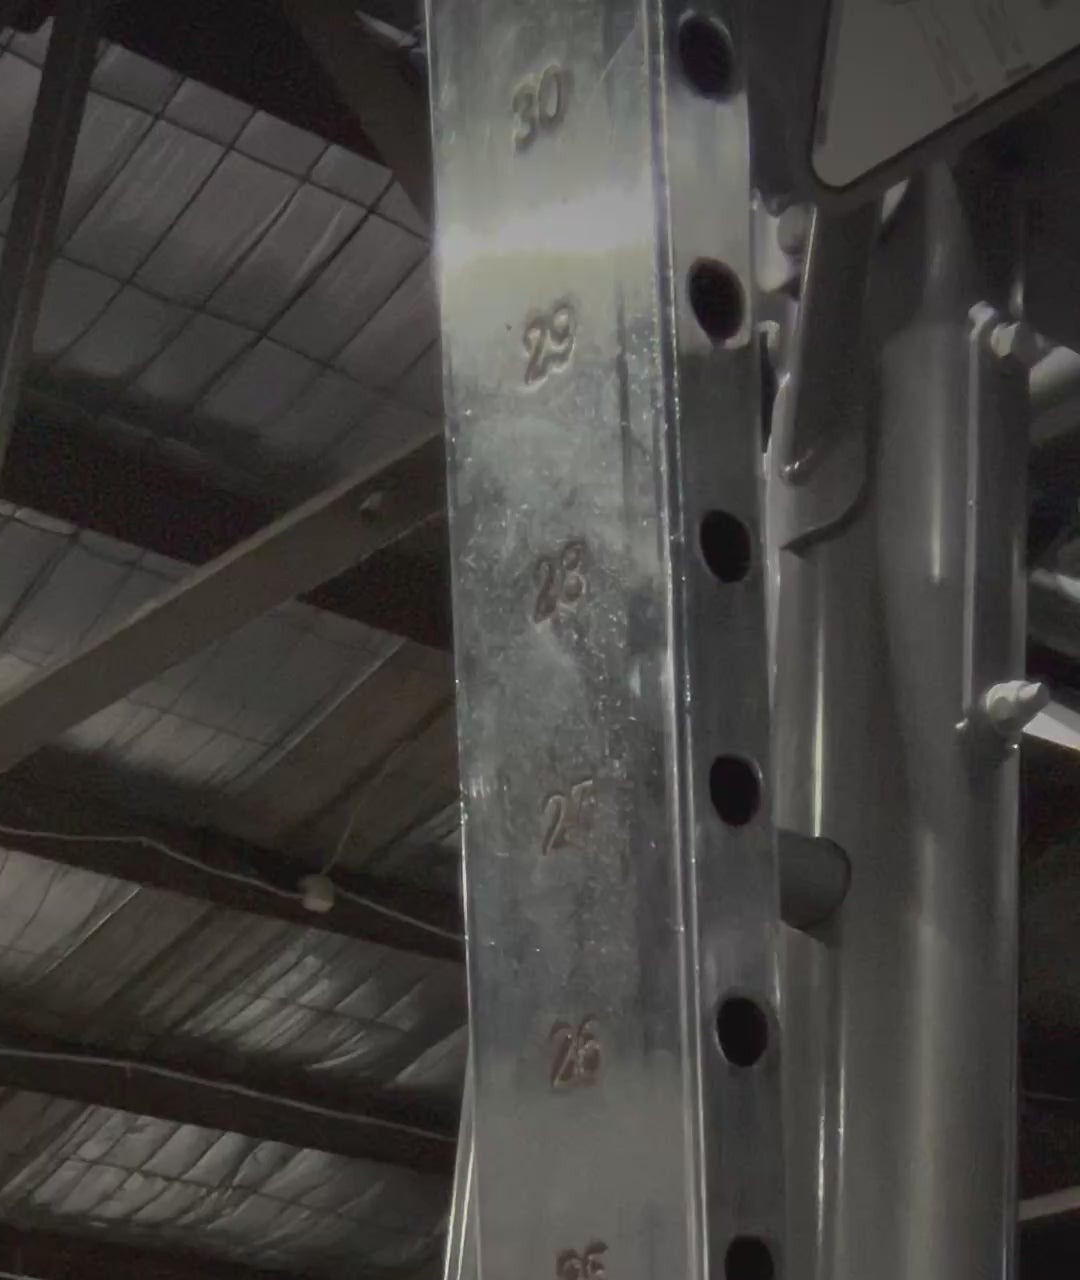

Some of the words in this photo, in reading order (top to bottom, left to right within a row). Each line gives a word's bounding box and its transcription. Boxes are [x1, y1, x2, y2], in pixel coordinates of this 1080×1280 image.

[512, 65, 565, 152] 30
[524, 302, 577, 389] 29
[551, 1013, 601, 1090] 26
